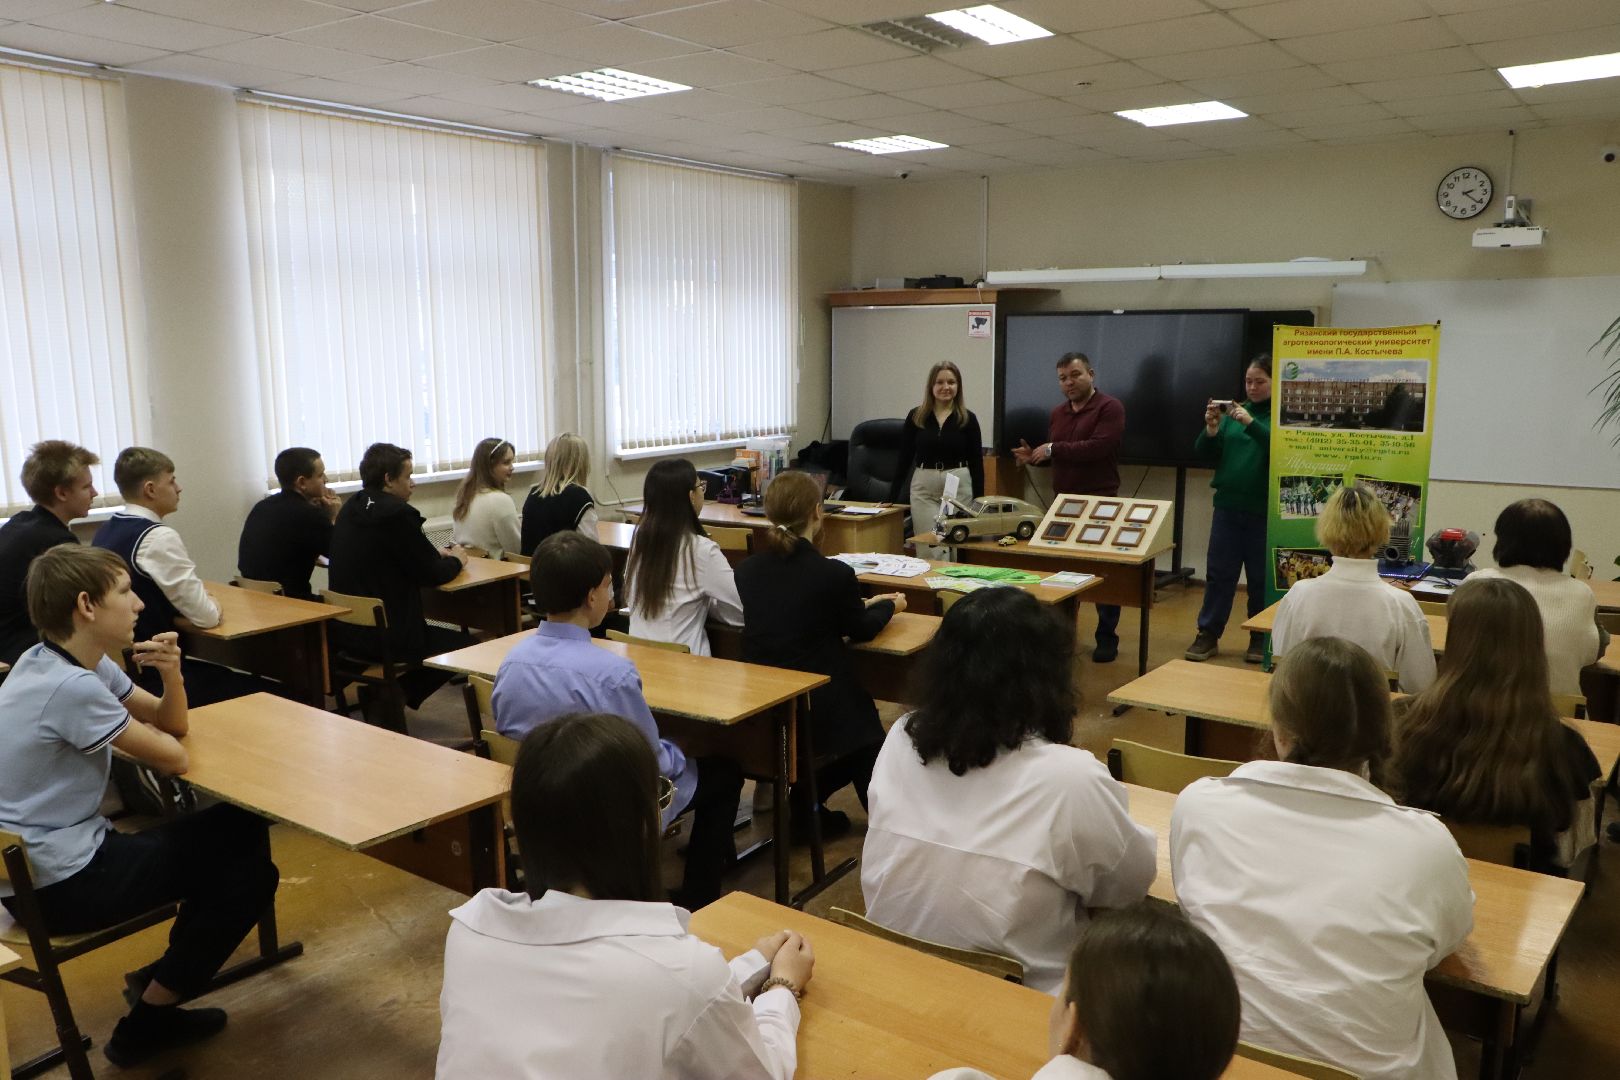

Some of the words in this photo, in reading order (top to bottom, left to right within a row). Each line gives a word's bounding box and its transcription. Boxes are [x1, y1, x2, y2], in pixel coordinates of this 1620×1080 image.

[1282, 339, 1372, 347] агротехнологический
[1374, 337, 1432, 347] университет
[1335, 347, 1353, 356] П.А.
[1354, 347, 1403, 356] Костычева
